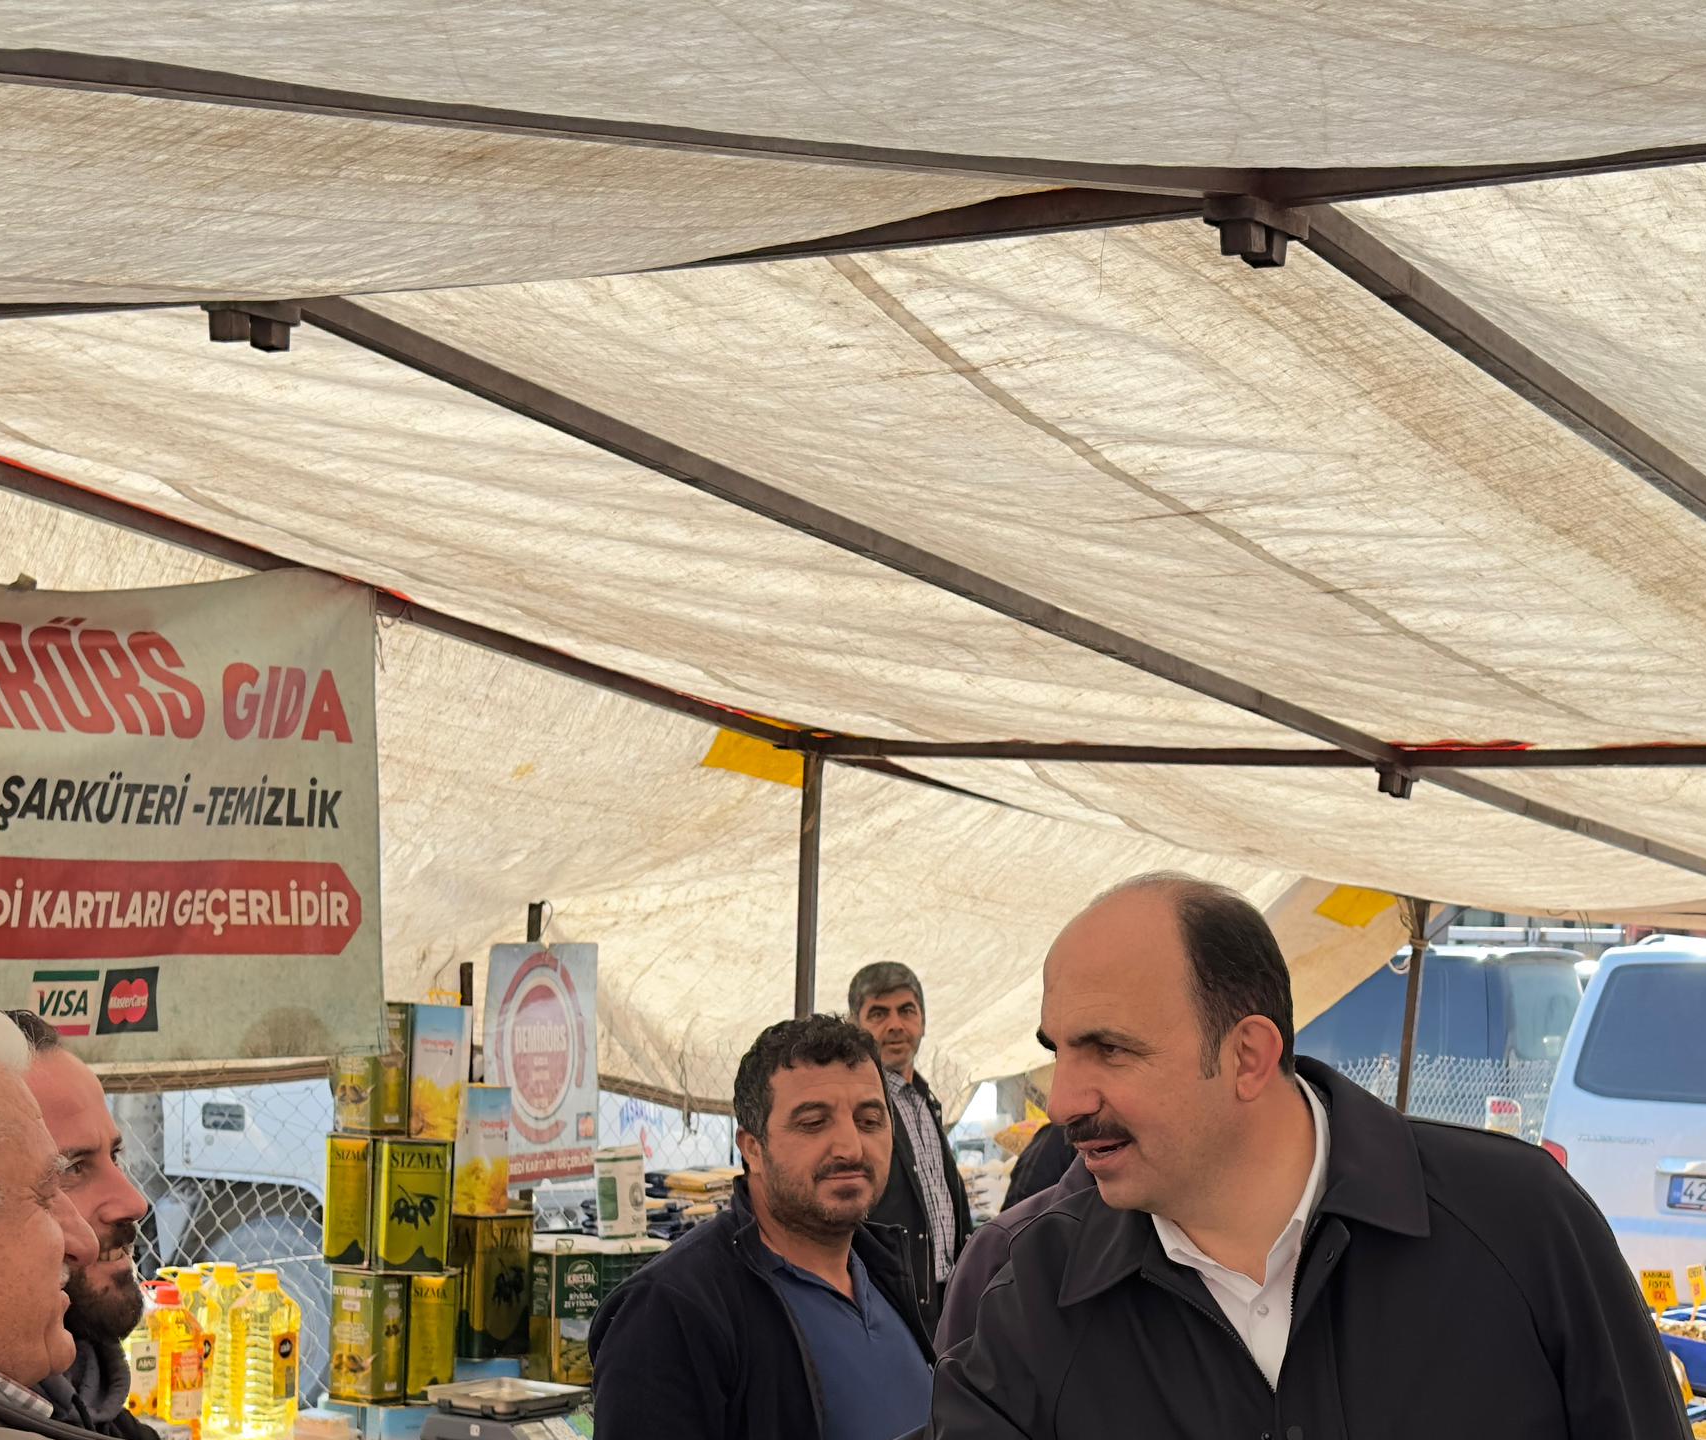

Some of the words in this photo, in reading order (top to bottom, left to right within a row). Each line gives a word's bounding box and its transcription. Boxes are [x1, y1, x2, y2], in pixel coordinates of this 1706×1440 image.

[222, 662, 354, 743] GIDA
[28, 889, 168, 929] KARTLARI
[173, 879, 350, 936] GEÇERLİDİR
[37, 988, 89, 1017] VISA
[391, 1151, 444, 1170] SIZMA
[413, 1286, 448, 1300] SIZMA
